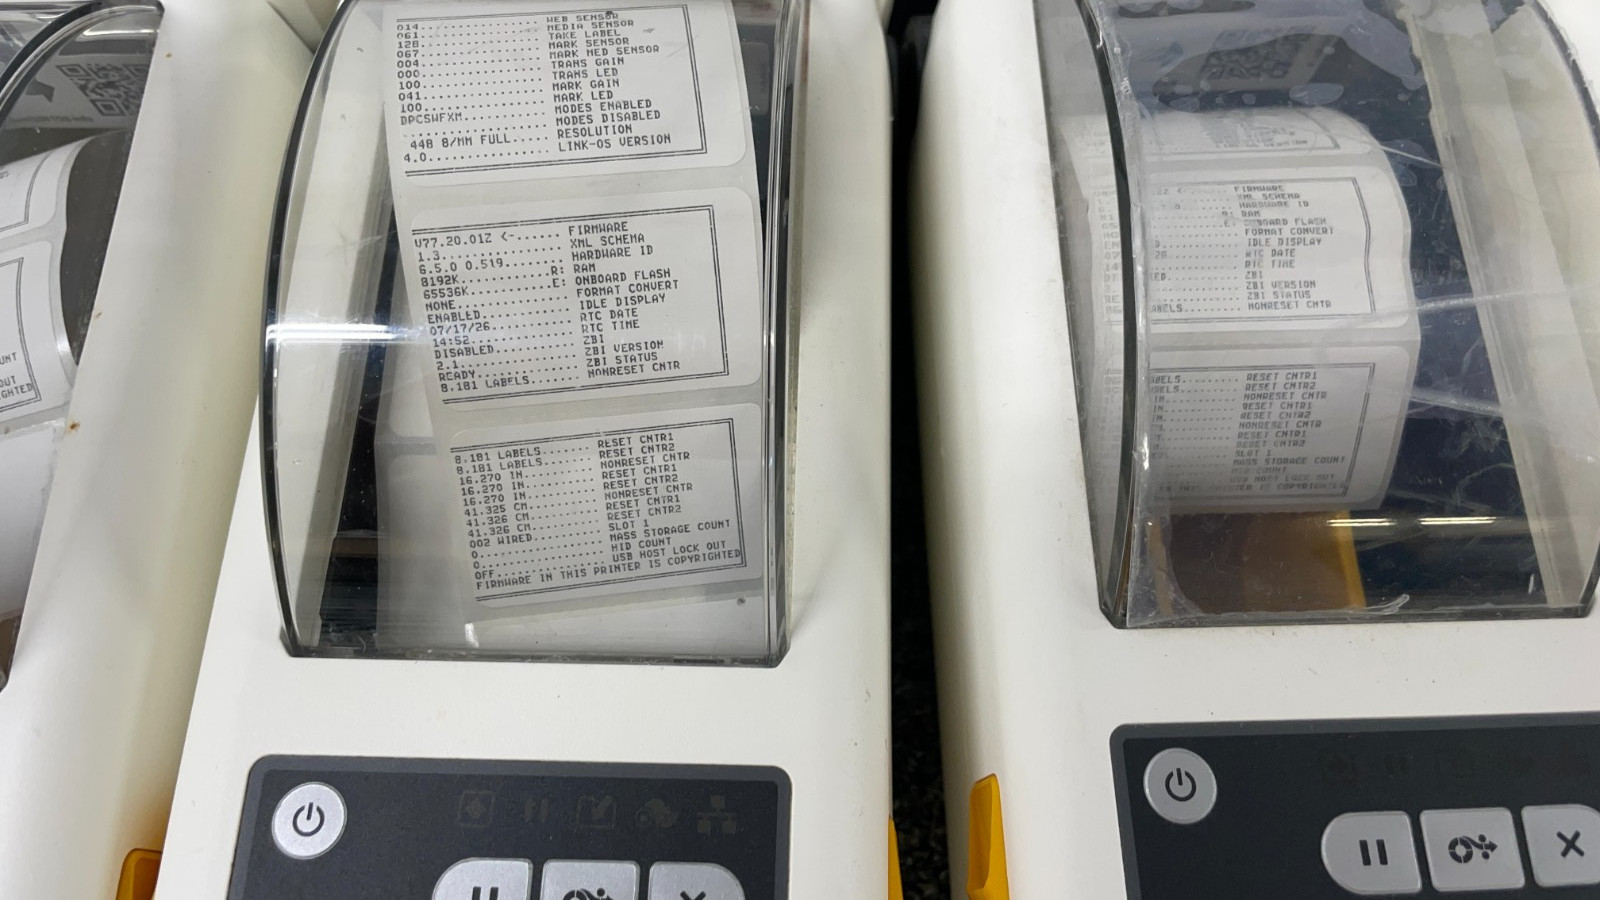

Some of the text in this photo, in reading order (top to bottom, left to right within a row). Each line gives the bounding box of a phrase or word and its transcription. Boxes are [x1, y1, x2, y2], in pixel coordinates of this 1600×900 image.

[592, 20, 634, 28] SENSOR
[549, 32, 576, 40] TAKE
[585, 29, 621, 38] LABEL
[549, 40, 578, 49] MARK
[586, 37, 630, 47] SENSOR
[550, 50, 579, 59] MARK
[587, 48, 608, 57] MED
[616, 45, 659, 55] SENSOR
[551, 59, 587, 69] TRANS
[596, 57, 625, 66] GAIN
[552, 70, 588, 80] TRANS
[596, 68, 618, 77] LED
[553, 81, 582, 91] MARK
[590, 78, 620, 89] GAIN
[554, 92, 583, 102] MARK
[591, 90, 614, 100] LED
[555, 103, 592, 114] MODES
[600, 99, 652, 111] ENABLED
[556, 110, 661, 126] MODES DISABLED
[411, 139, 433, 149] 448
[442, 136, 473, 147] 8/MM
[557, 124, 633, 139] RESOLUTION
[559, 139, 612, 152] LINK-OS
[619, 133, 671, 147] VERSION
[568, 221, 628, 236] FIRMWARE
[570, 237, 592, 248] XML
[601, 233, 645, 246] SCHEMA
[1278, 238, 1322, 246] DISPLAY
[572, 247, 632, 261] HARDWARE
[641, 245, 653, 255] ID
[573, 263, 596, 274] RAM
[575, 272, 627, 286] ONBOARD
[635, 268, 671, 280] FLASH
[576, 285, 621, 299] FORMAT
[629, 280, 679, 293] CONVERT
[580, 299, 607, 310] IDLE
[616, 293, 666, 306] DISPLAY
[580, 311, 602, 322] RTC
[610, 308, 638, 319] DATE
[582, 323, 603, 333] RTC
[612, 319, 640, 330] TIME
[583, 334, 604, 345] ZBI
[585, 345, 605, 356] ZBI
[614, 340, 664, 353] VERSION
[587, 357, 607, 368] ZBI
[616, 352, 658, 364] STATUS
[588, 364, 644, 378] NONRESET
[652, 361, 680, 371] CNTR
[598, 437, 632, 448] RESET
[640, 433, 674, 444] CNTR1
[599, 447, 633, 459] RESET
[641, 443, 675, 454] CNTR2
[510, 471, 523, 479] IN
[601, 455, 655, 469] NONRESET
[663, 452, 690, 462] CNTR
[512, 481, 525, 490] IN
[602, 468, 636, 479] RESET
[644, 464, 677, 475] CNTR1
[514, 492, 526, 501] IN
[603, 479, 637, 490] RESET
[645, 474, 678, 486] CNTR2
[605, 486, 658, 500] NONRESET
[666, 483, 693, 493] CNTR
[606, 499, 639, 510] RESET
[647, 494, 680, 506] CNTR1
[607, 509, 640, 520] RESET
[648, 505, 682, 516] CNTR2
[609, 520, 635, 531] SLOT
[644, 519, 649, 527] 1
[610, 531, 637, 541] MASS
[644, 524, 690, 537] STORAGE
[698, 519, 731, 530] COUNT
[612, 541, 631, 552] HID
[639, 537, 672, 549] COUNT
[613, 553, 633, 563] USB
[640, 548, 666, 559] HOST
[673, 544, 699, 555] LOCK
[707, 540, 726, 550] OUT
[477, 549, 741, 590] FIRMWARE IN THIS PRINTER IS COPYRIGHTED
